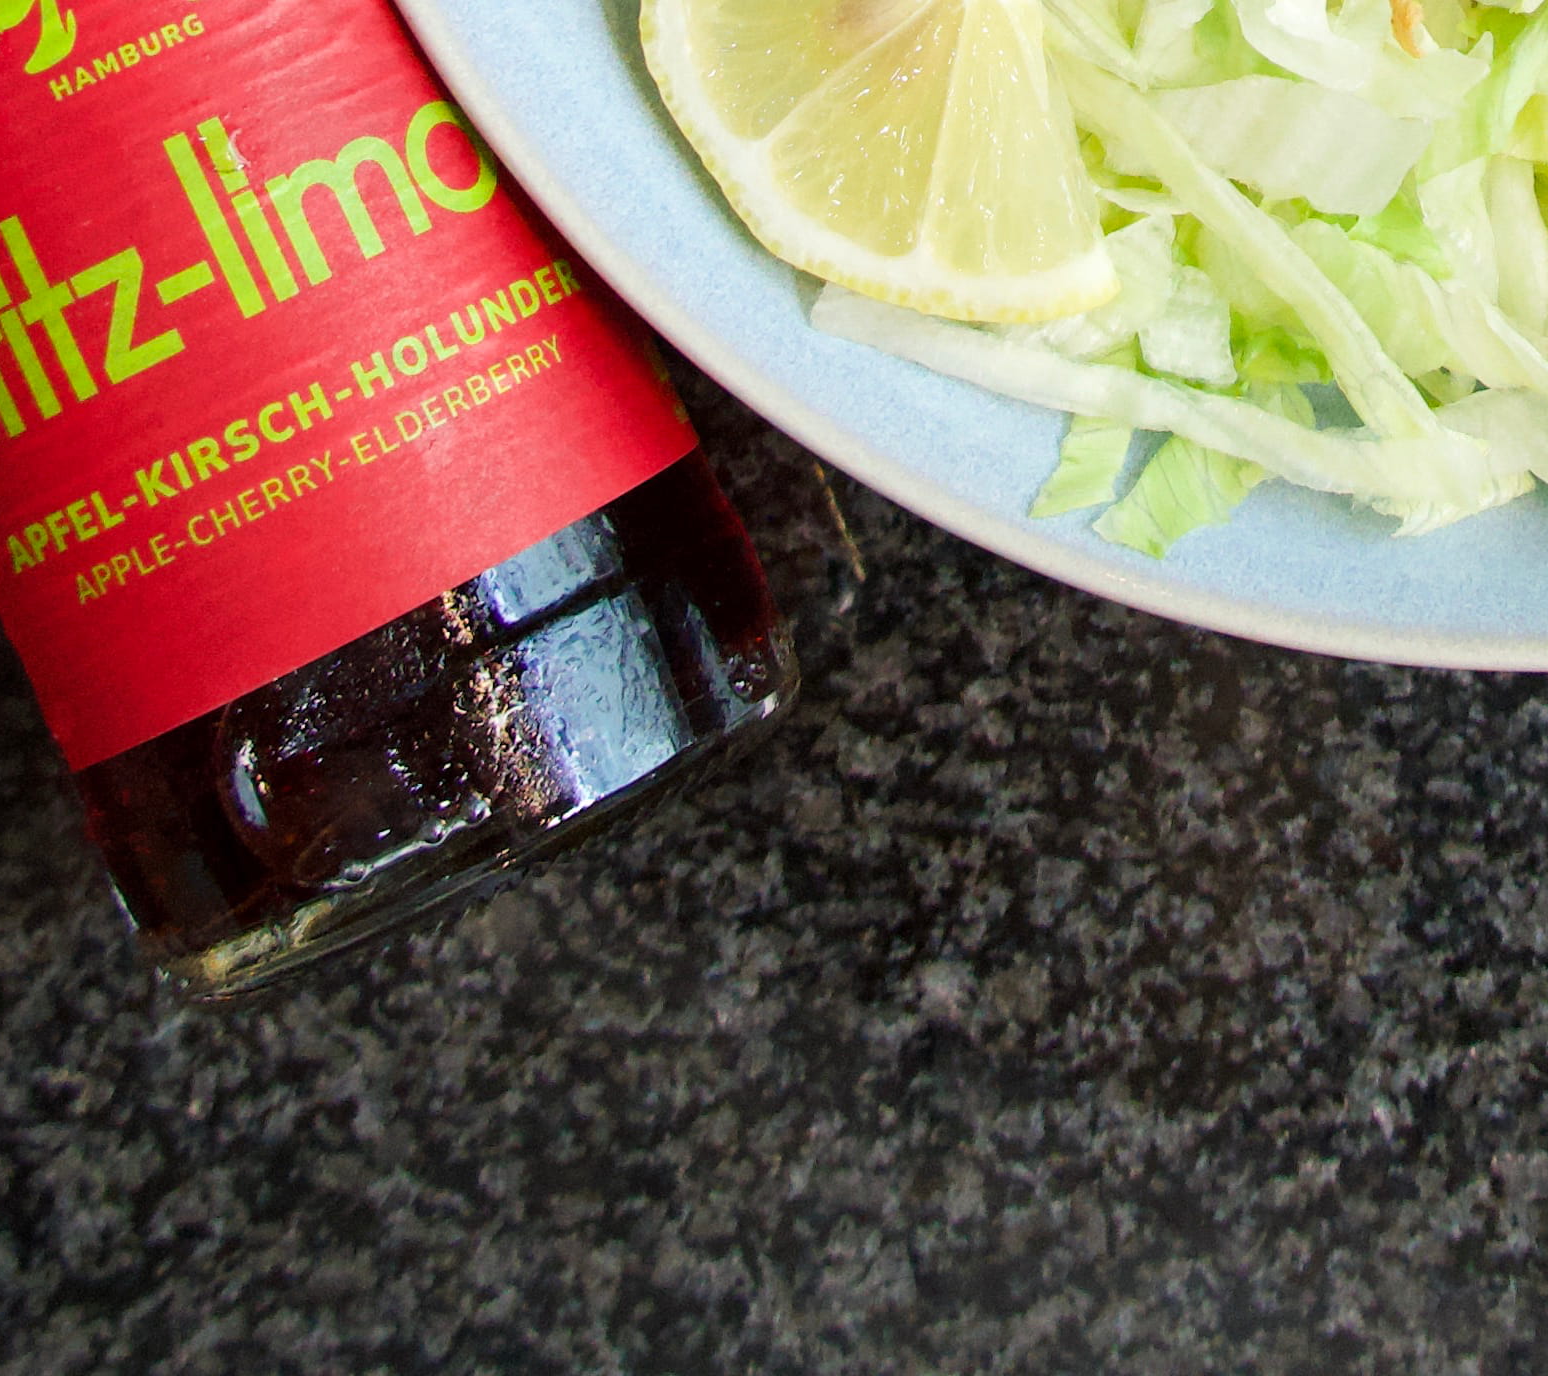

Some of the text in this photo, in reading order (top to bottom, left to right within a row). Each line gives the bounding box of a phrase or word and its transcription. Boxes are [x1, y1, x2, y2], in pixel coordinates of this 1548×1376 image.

[49, 13, 204, 101] HAMBURG
[7, 259, 581, 573] APFEL-KIRSCH-HOLUNDER
[75, 335, 563, 604] APPLE-CHERRY-ELDERBERRY
